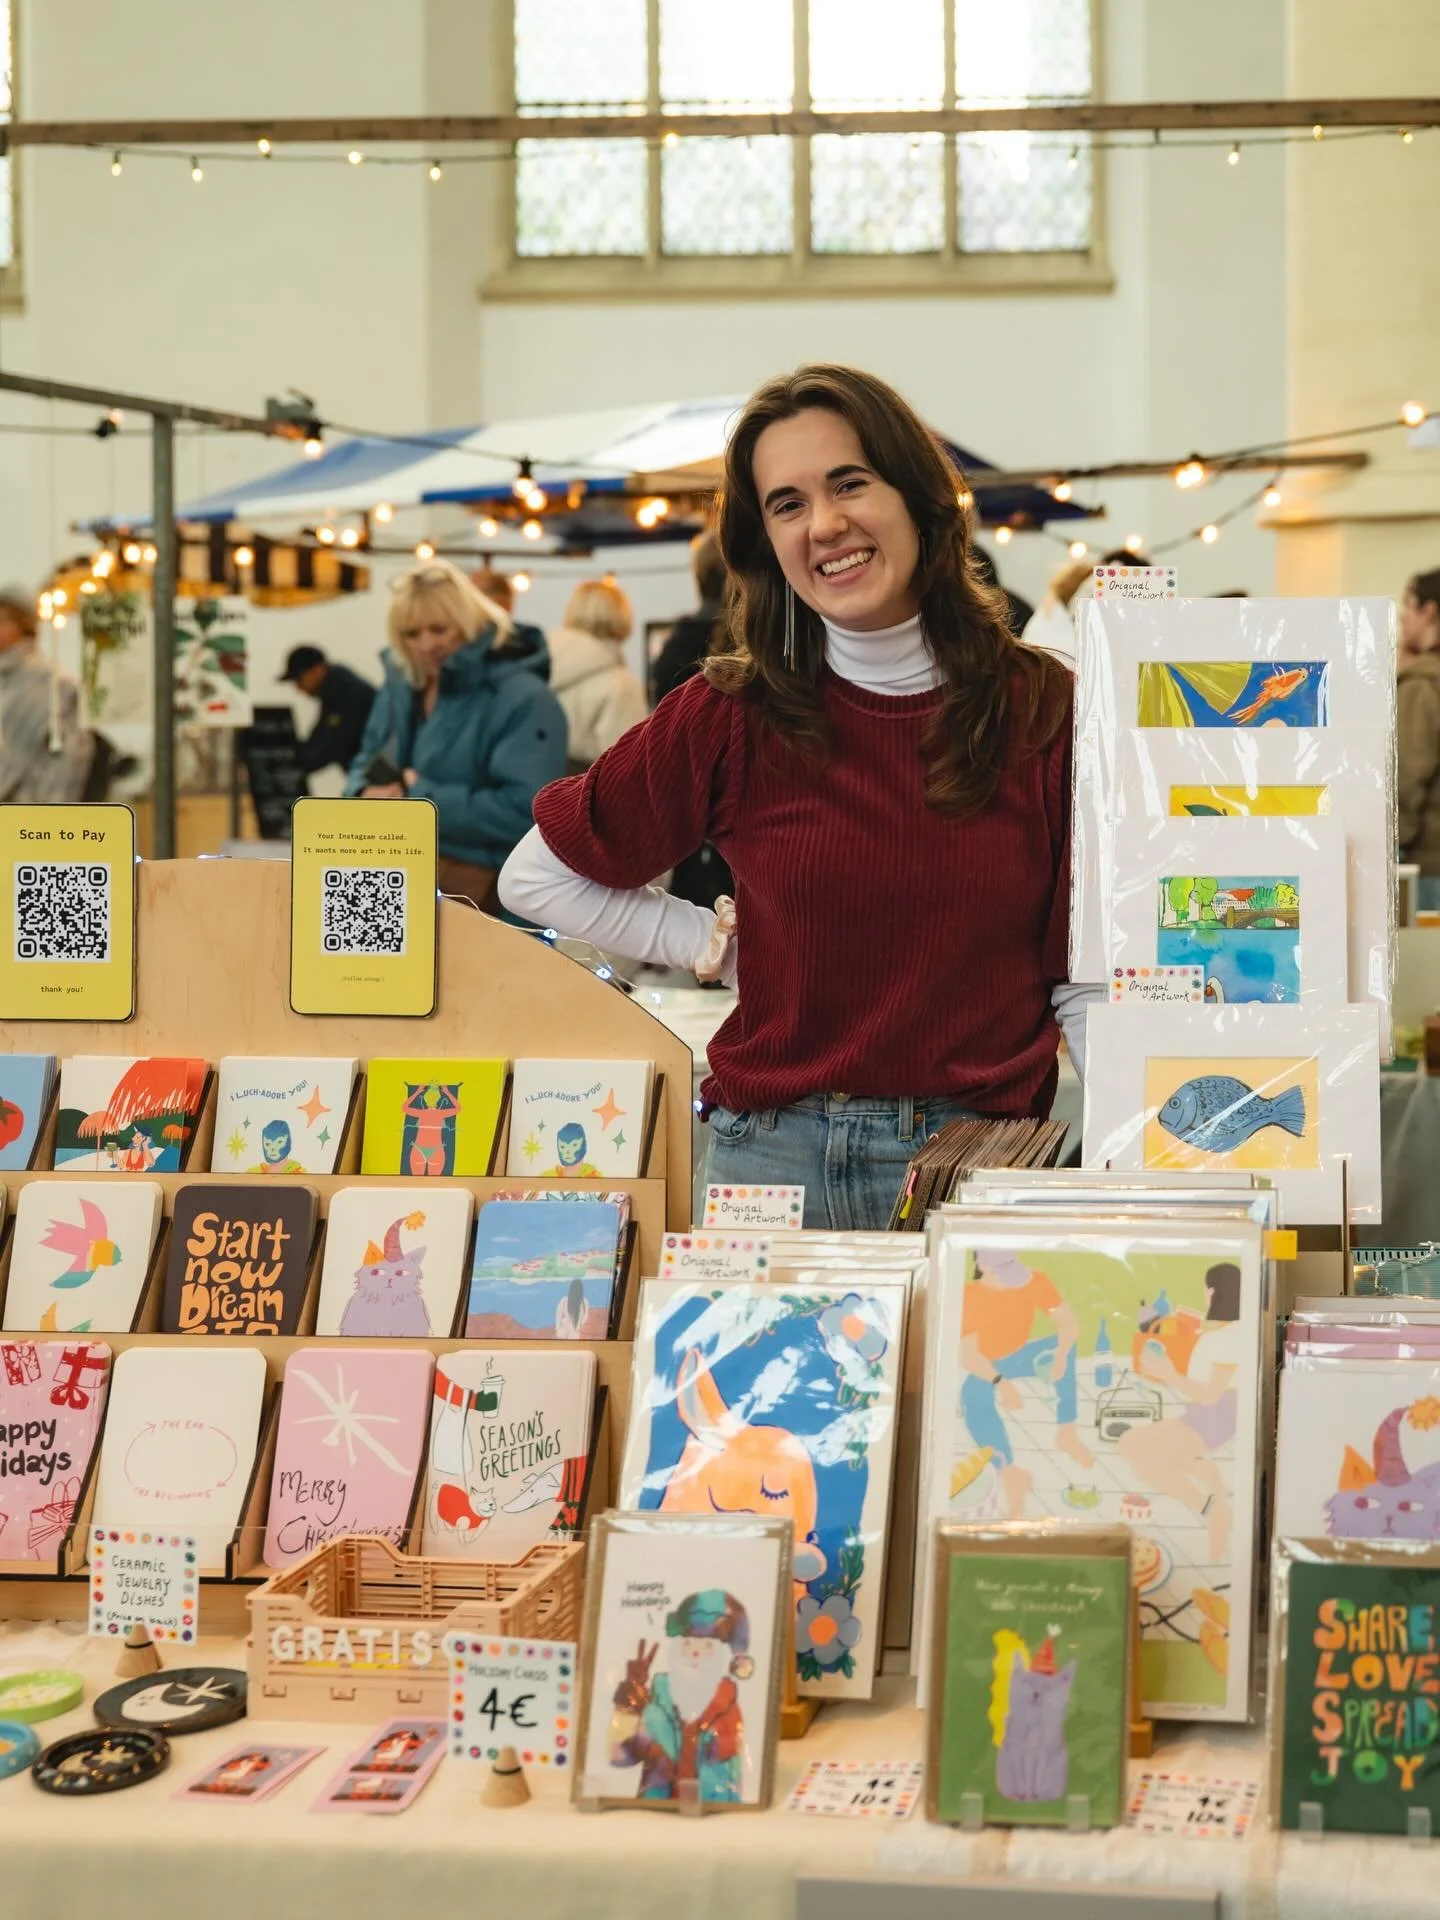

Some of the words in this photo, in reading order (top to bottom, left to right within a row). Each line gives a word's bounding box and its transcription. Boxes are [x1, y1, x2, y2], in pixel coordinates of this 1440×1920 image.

[1109, 580, 1149, 597] Original
[1127, 591, 1165, 599] Artwork
[20, 829, 51, 840] Scan
[59, 829, 75, 840] to
[82, 829, 106, 843] Pay
[338, 833, 376, 841] Instagram
[378, 833, 407, 841] called.
[405, 848, 425, 856] life.
[66, 986, 84, 995] you!
[1128, 980, 1169, 998] Original
[1149, 991, 1190, 1003] Artwork
[288, 1079, 309, 1097] YOU!
[721, 1202, 763, 1221] Original
[743, 1214, 786, 1225] Artwork
[186, 1211, 291, 1260] Start
[184, 1257, 284, 1290] now
[680, 1254, 730, 1274] Original
[703, 1268, 749, 1279] Artwork
[178, 1282, 284, 1329] Dream
[480, 1411, 544, 1454] SEASON'S
[480, 1429, 561, 1481] GREETINGS
[0, 1449, 72, 1486] idays
[116, 1573, 171, 1597] JEWELRY
[120, 1591, 165, 1607] DISHES
[1313, 1598, 1435, 1652] SHARE
[1314, 1652, 1440, 1690] LOVE
[479, 1686, 539, 1732] 4€
[1312, 1691, 1439, 1749] SPREAD
[1310, 1746, 1425, 1791] JOY
